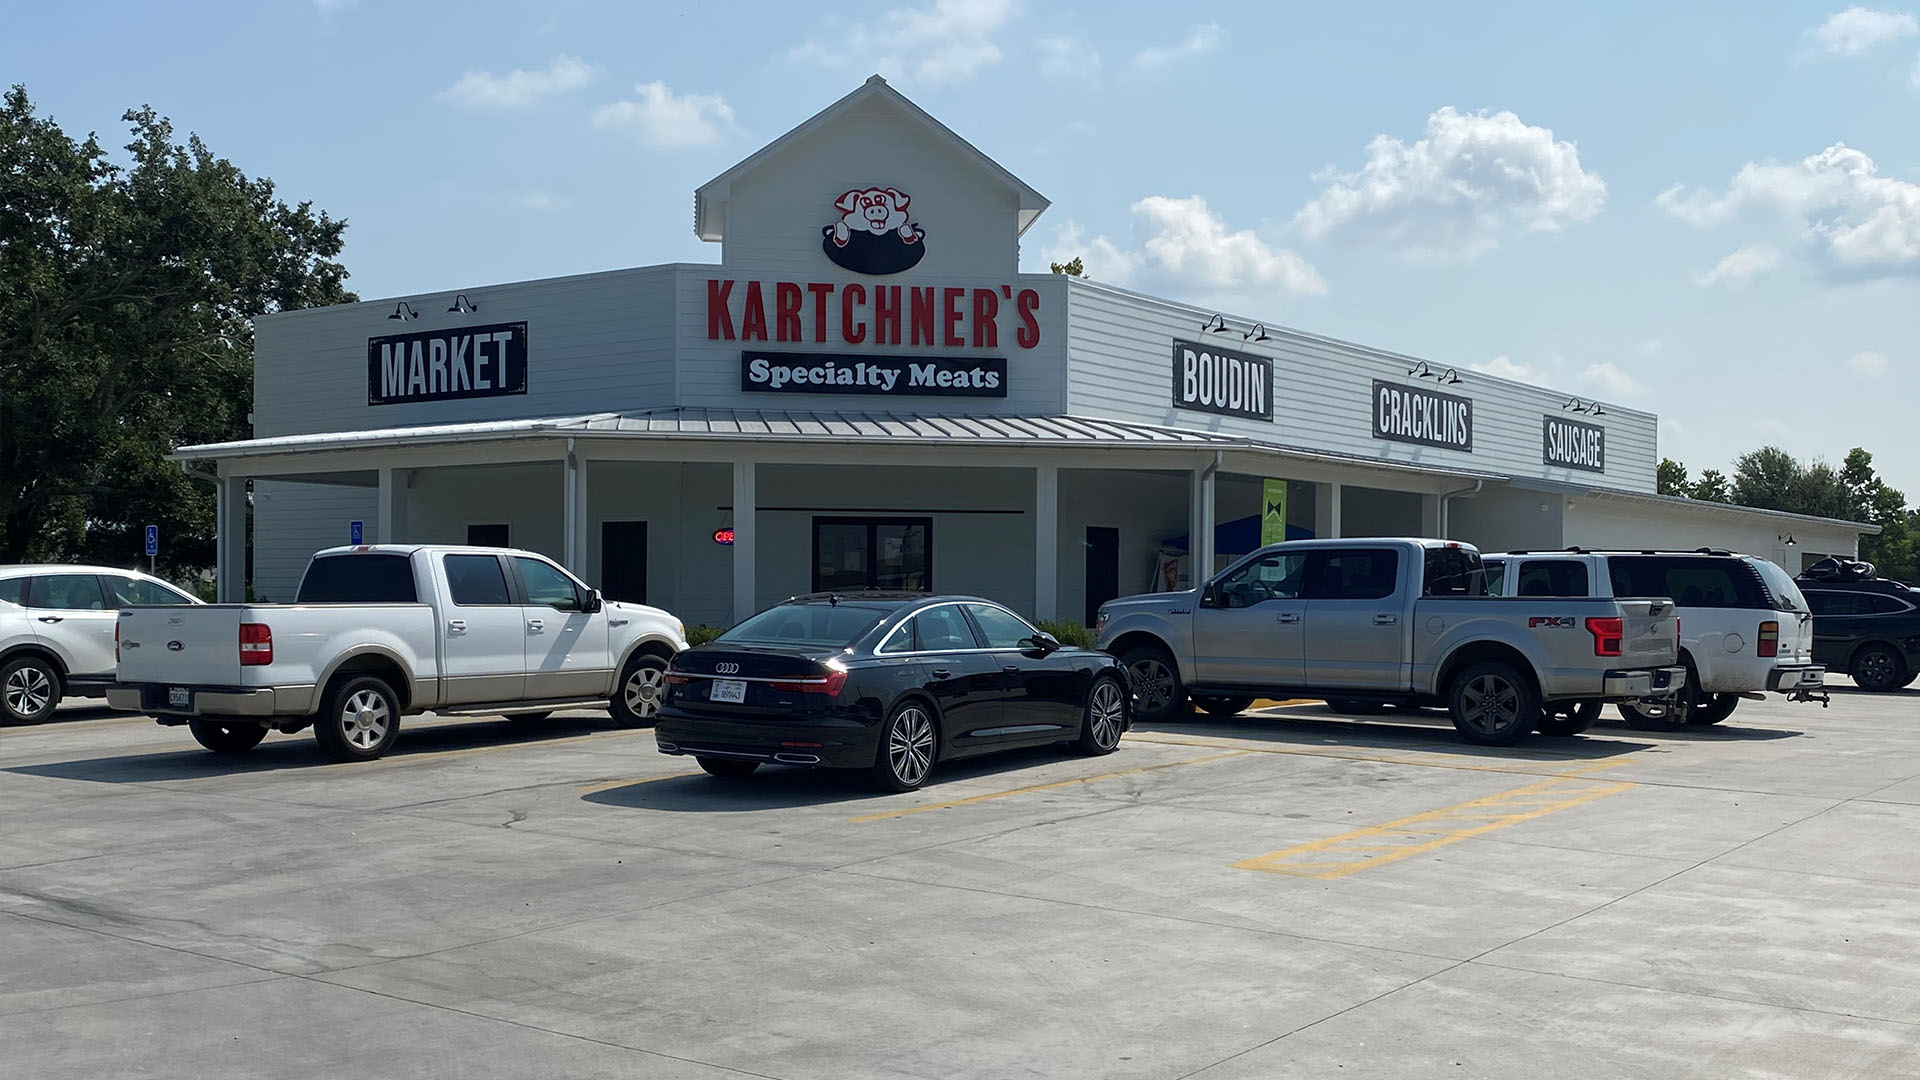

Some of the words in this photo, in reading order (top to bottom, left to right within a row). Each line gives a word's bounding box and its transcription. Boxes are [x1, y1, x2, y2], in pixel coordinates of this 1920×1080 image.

[708, 280, 1039, 349] KARTCHNER'S
[380, 330, 513, 398] MARKET
[749, 359, 901, 391] Specialty
[908, 363, 1000, 388] Meats
[1183, 349, 1265, 414] BOUDIN
[1378, 386, 1468, 446] CRACKLINS
[1547, 421, 1601, 468] SAUSAGE
[715, 531, 735, 541] OPE
[1528, 616, 1576, 628] FX4
